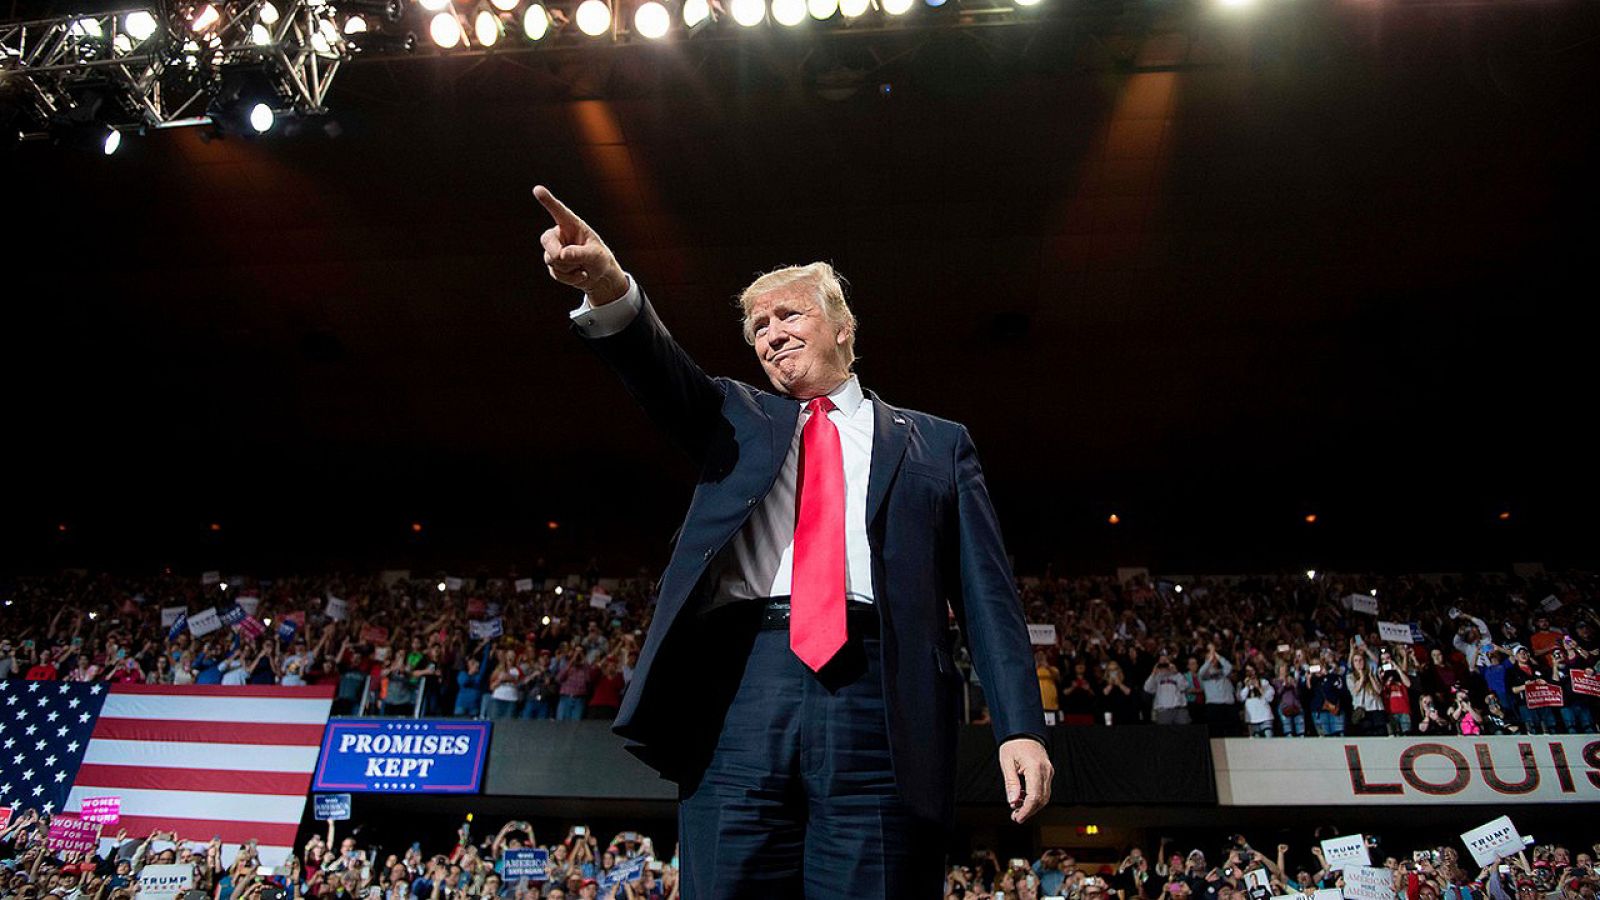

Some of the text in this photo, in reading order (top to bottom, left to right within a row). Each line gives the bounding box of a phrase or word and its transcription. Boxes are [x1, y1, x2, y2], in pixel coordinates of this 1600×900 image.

[338, 734, 470, 755] PROMISES
[364, 758, 434, 778] KEPT
[82, 798, 121, 807] WOMEN
[83, 814, 118, 823] TRUMP
[53, 819, 102, 832] WOMEN
[63, 831, 81, 839] FOR
[1471, 826, 1510, 849] TRUMP
[48, 838, 93, 852] TRUMP
[1327, 844, 1361, 854] TRUMP
[1360, 868, 1375, 877] BUY
[142, 876, 187, 885] TRUMP
[1348, 874, 1390, 885] AMERICAN
[1347, 887, 1391, 899] AMERICAN
